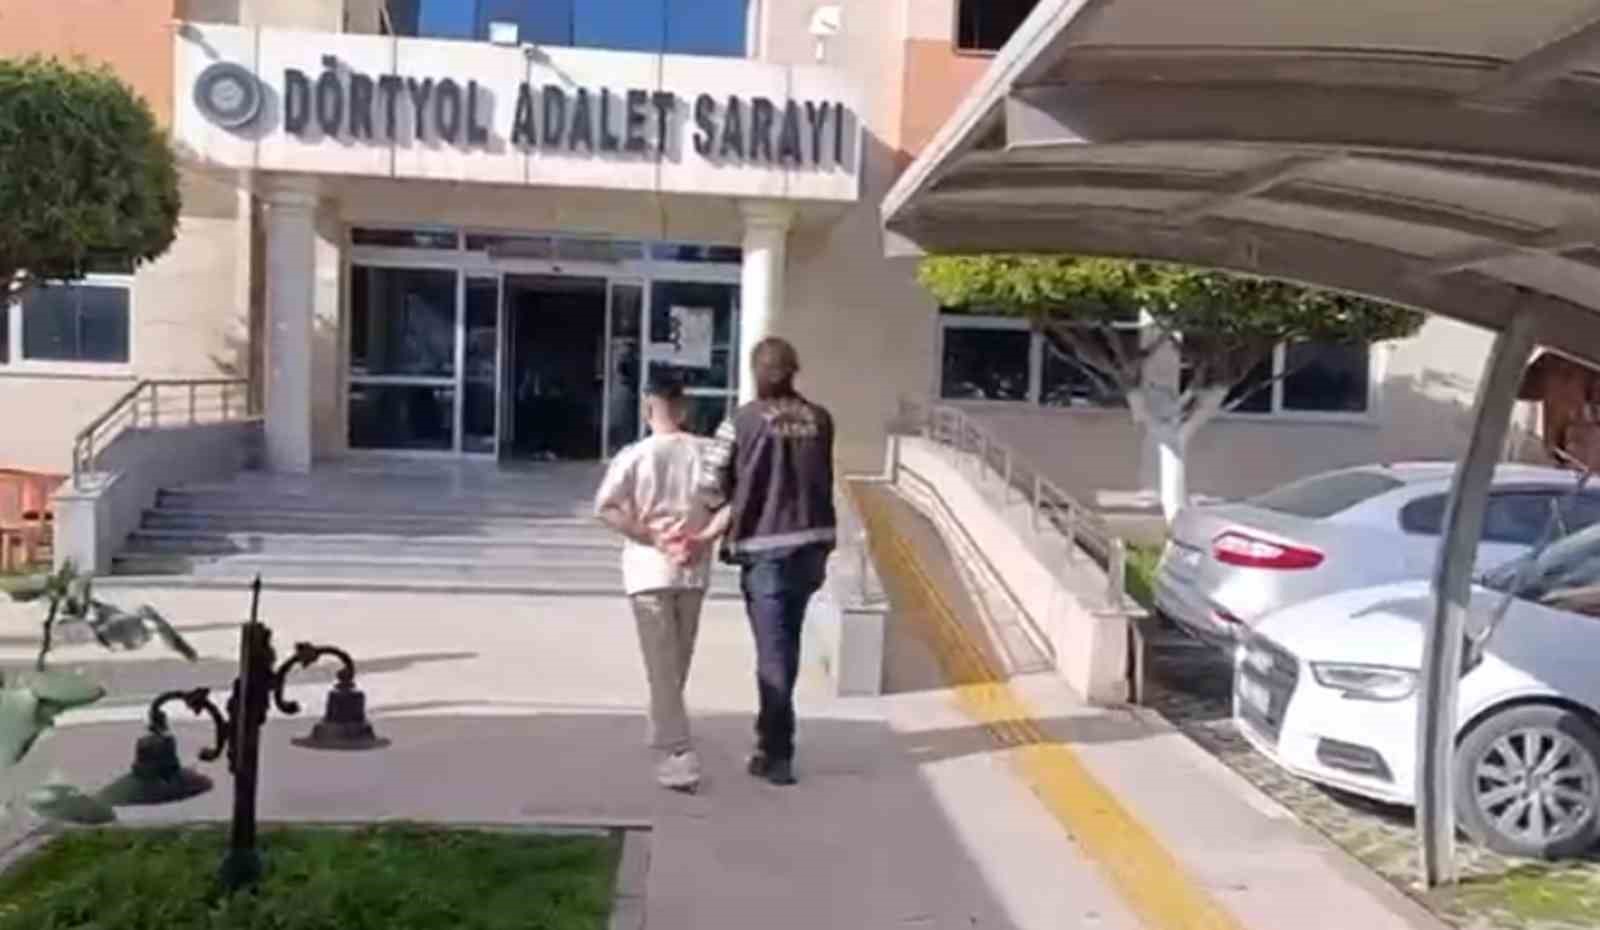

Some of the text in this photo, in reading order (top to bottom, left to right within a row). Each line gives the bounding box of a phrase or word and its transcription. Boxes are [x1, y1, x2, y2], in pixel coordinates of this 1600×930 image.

[283, 55, 846, 165] DÖRTYOL ADALET SARAYI
